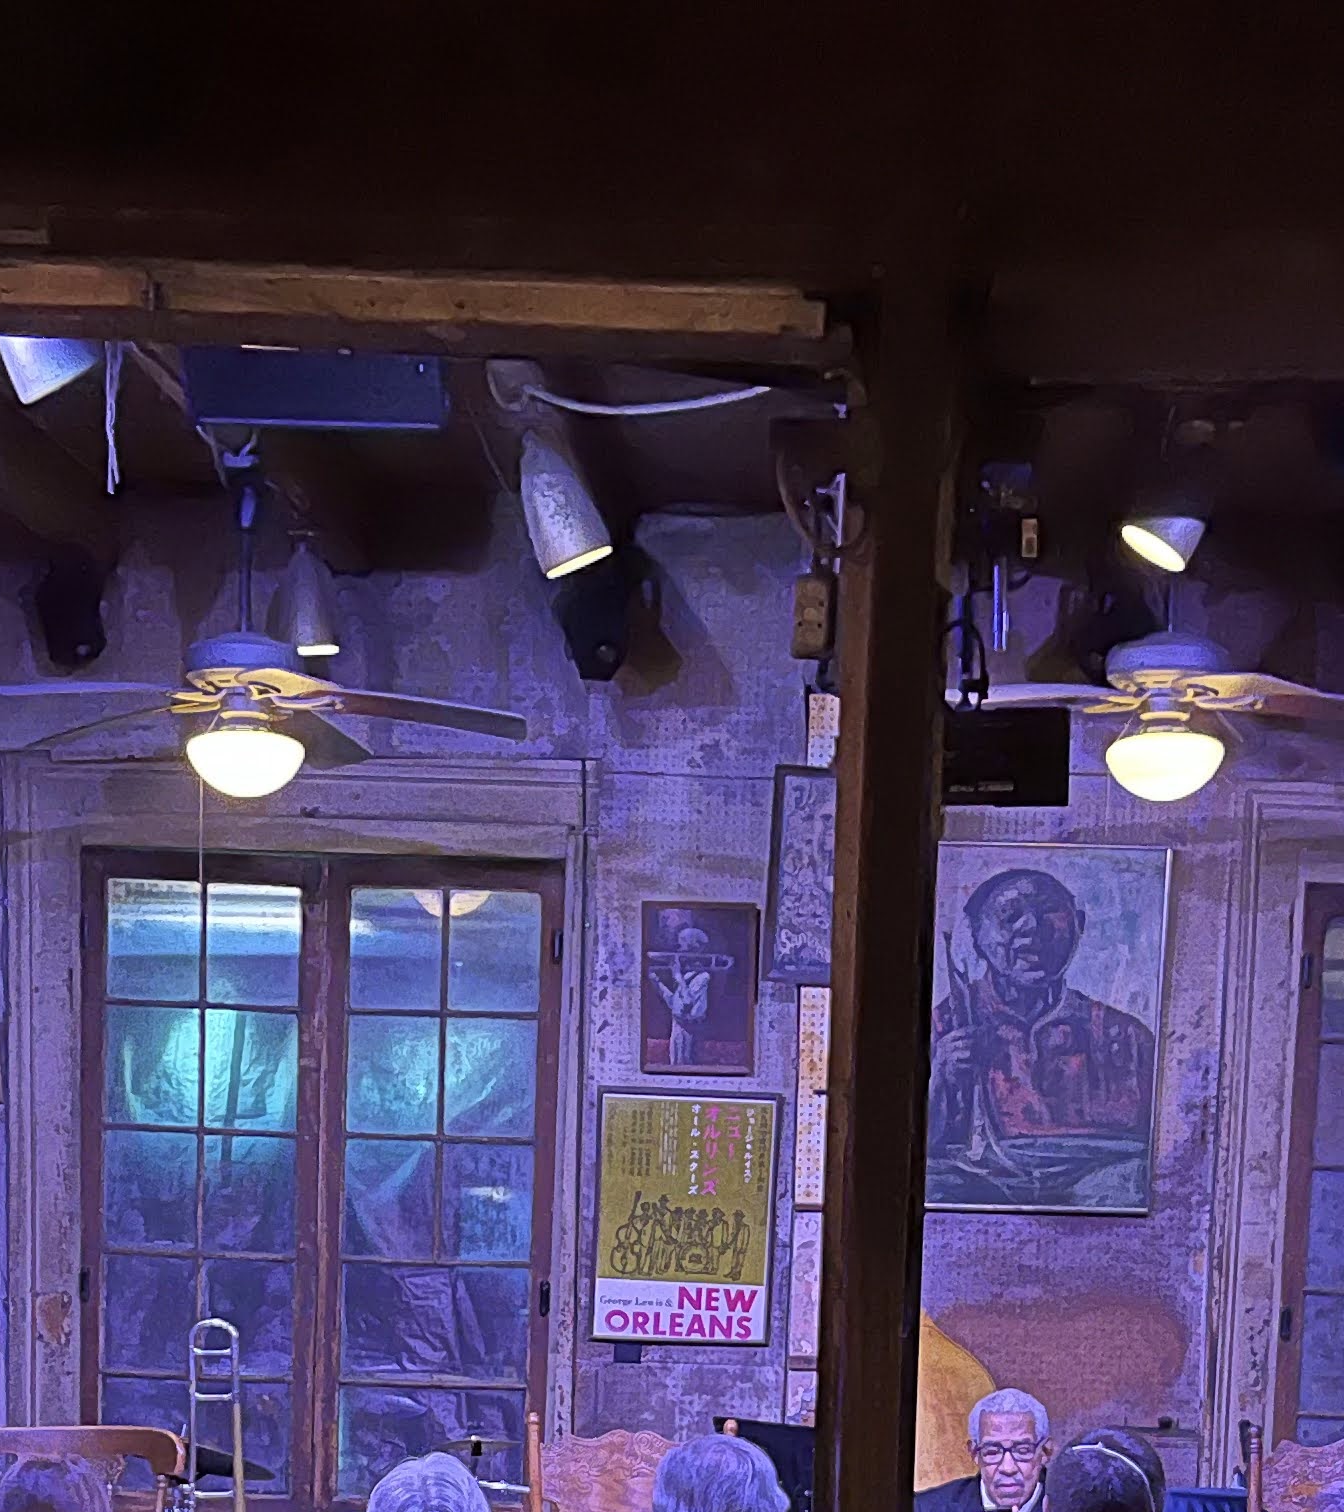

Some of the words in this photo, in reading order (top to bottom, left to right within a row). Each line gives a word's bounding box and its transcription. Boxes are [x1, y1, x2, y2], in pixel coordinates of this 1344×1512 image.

[599, 1295, 633, 1306] George
[665, 1298, 673, 1307] &
[677, 1285, 758, 1313] NEW
[605, 1309, 752, 1340] ORLEANS
